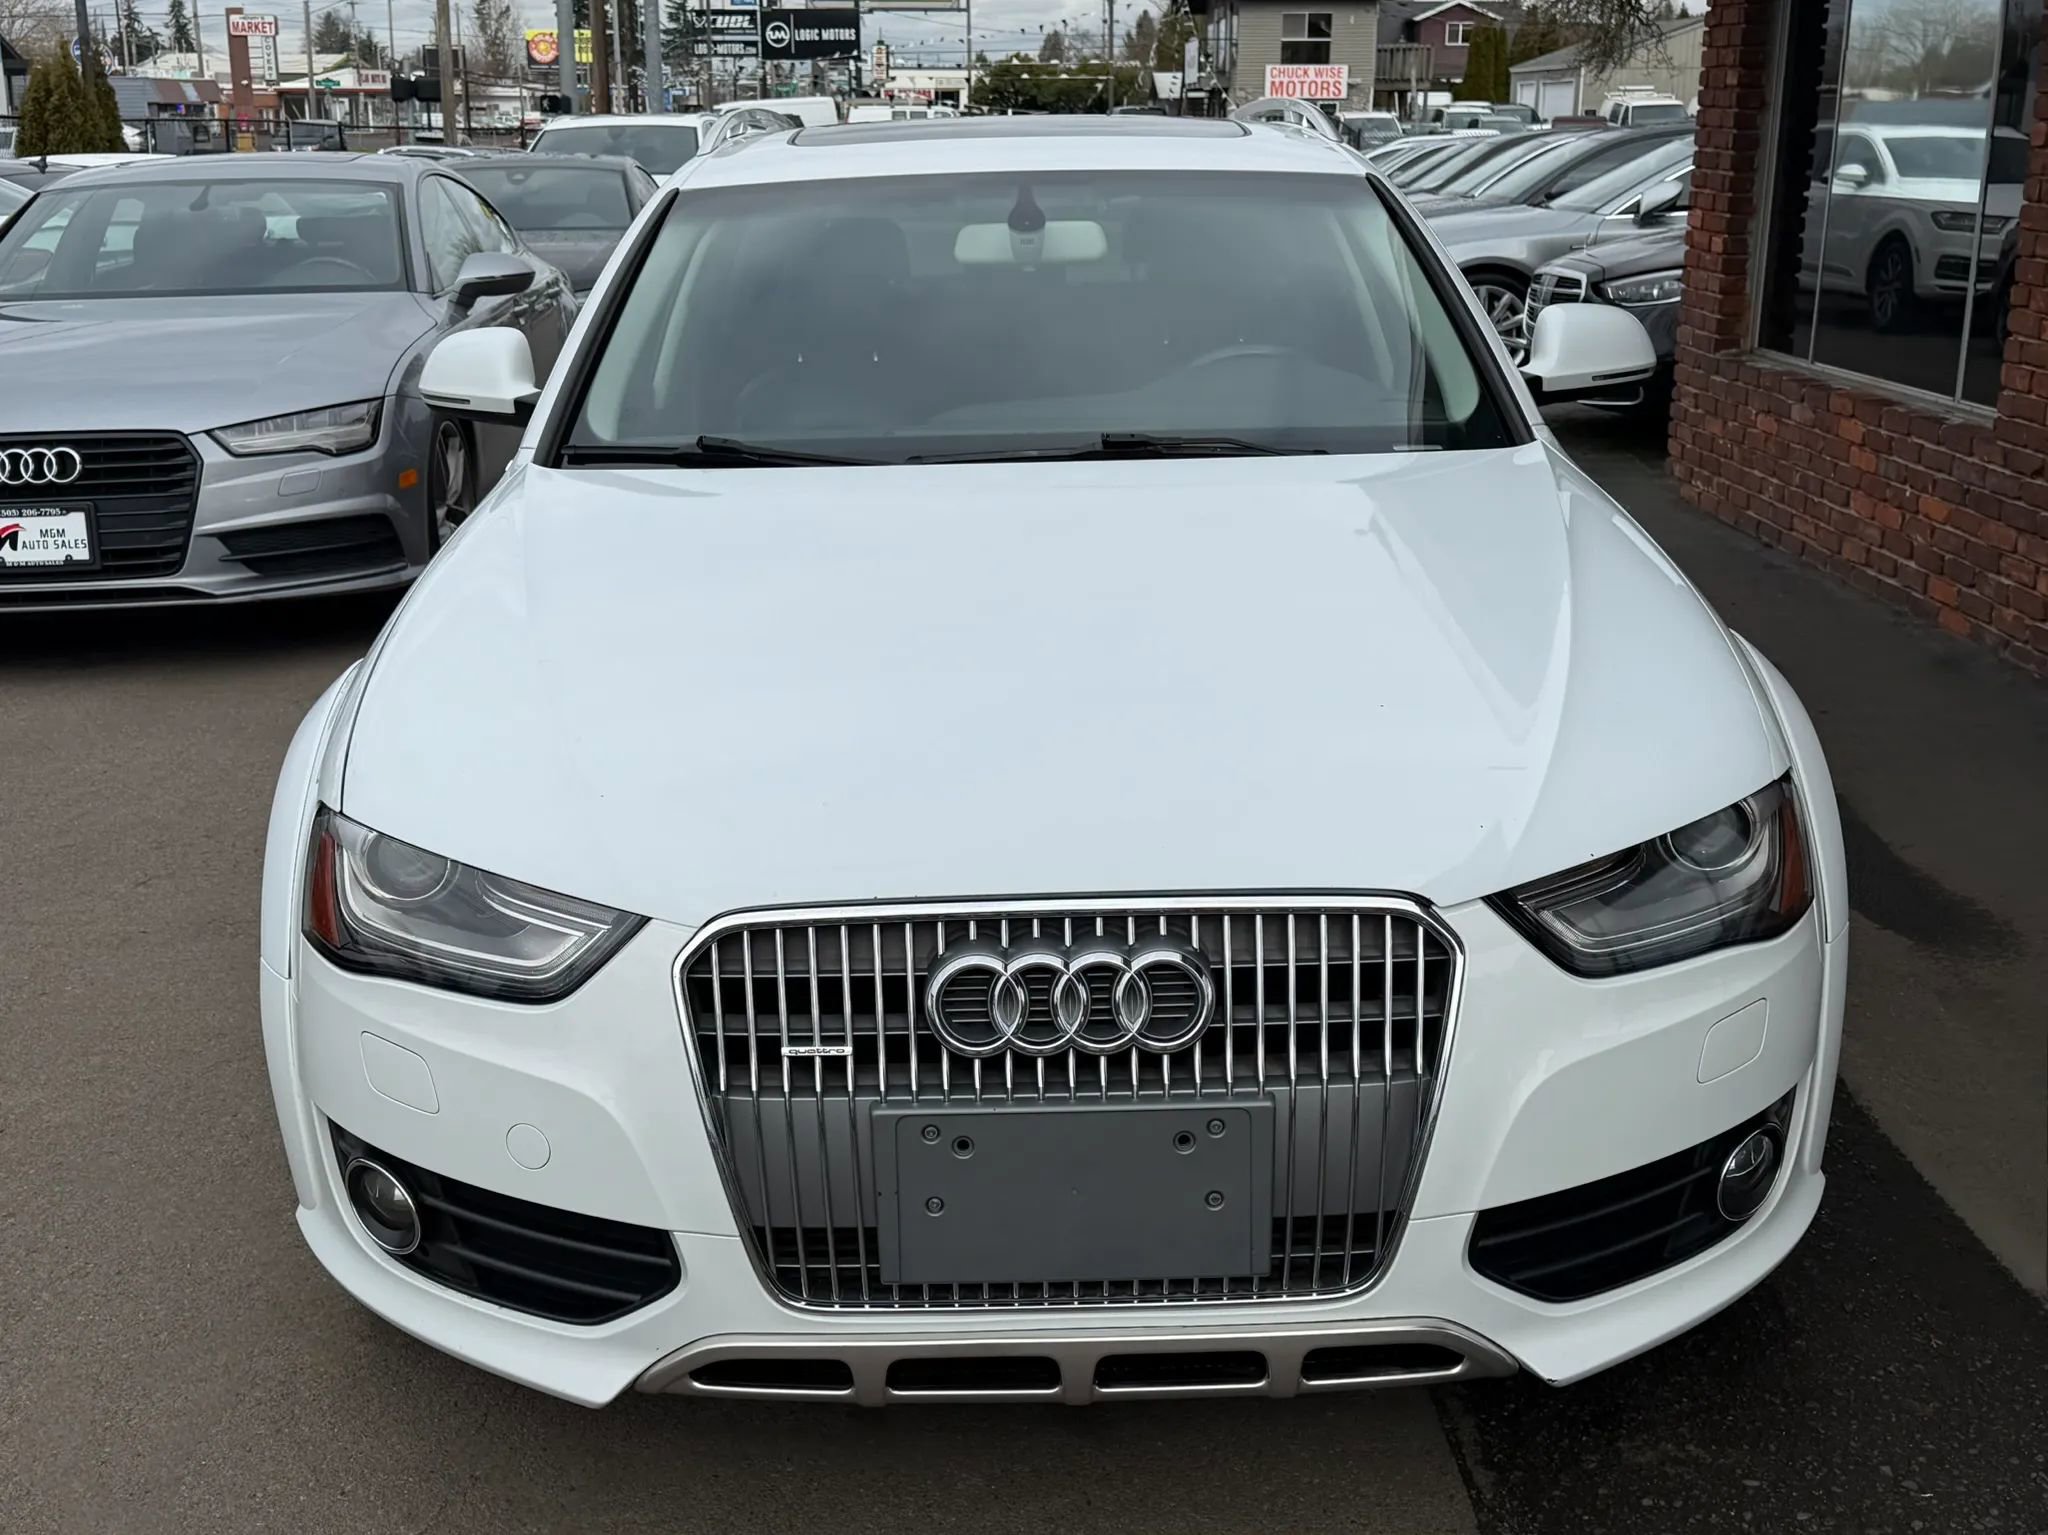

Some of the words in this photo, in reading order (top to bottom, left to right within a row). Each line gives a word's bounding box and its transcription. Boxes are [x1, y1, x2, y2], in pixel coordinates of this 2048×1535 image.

[231, 21, 274, 34] MARKET
[794, 28, 820, 41] LOGIC
[821, 28, 856, 41] MOTORS
[1270, 67, 1310, 79] CHUCK
[1314, 67, 1344, 79] WISE
[1270, 80, 1342, 97] MOTORS
[21, 508, 61, 517] 206-7795
[22, 540, 49, 551] AUTO
[54, 538, 87, 550] SALES
[788, 1048, 845, 1056] quattro
